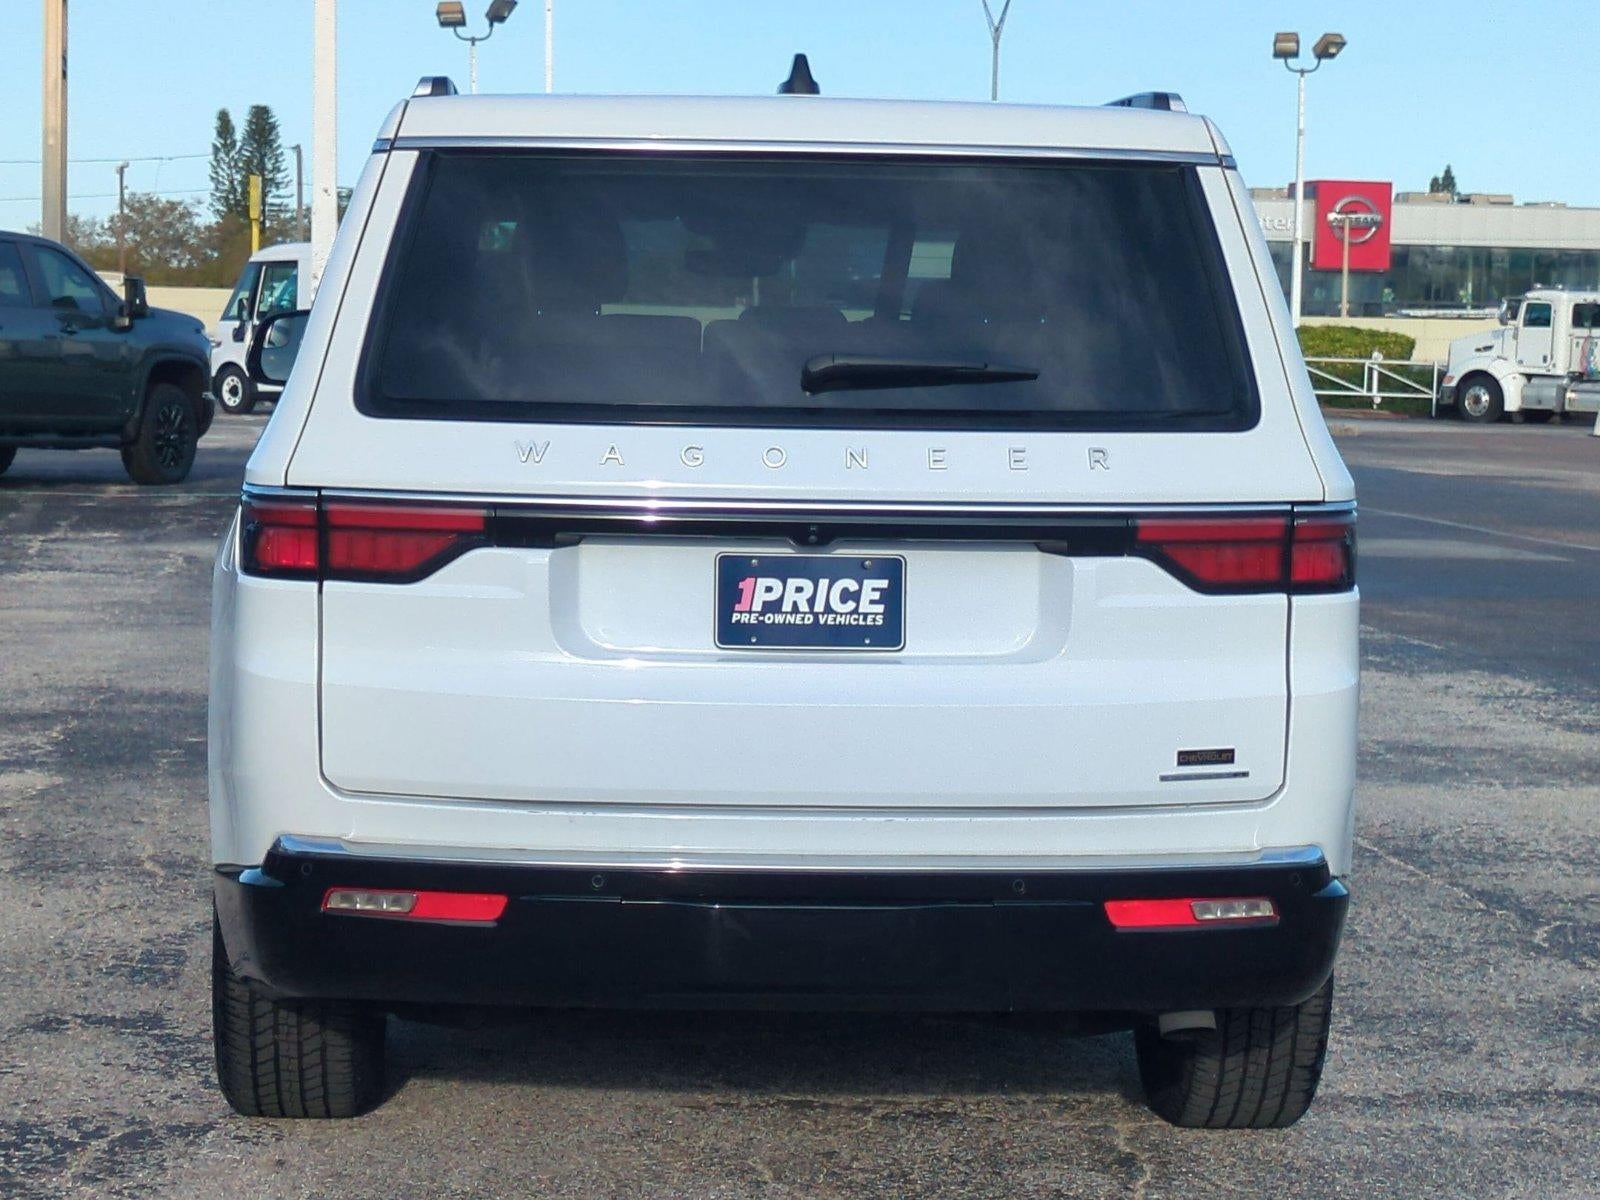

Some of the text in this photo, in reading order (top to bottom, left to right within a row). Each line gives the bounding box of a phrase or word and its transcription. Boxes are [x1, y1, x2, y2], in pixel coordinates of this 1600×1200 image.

[515, 440, 1111, 470] WAGONEER
[731, 613, 884, 625] PRE-OWNED VEHICLES
